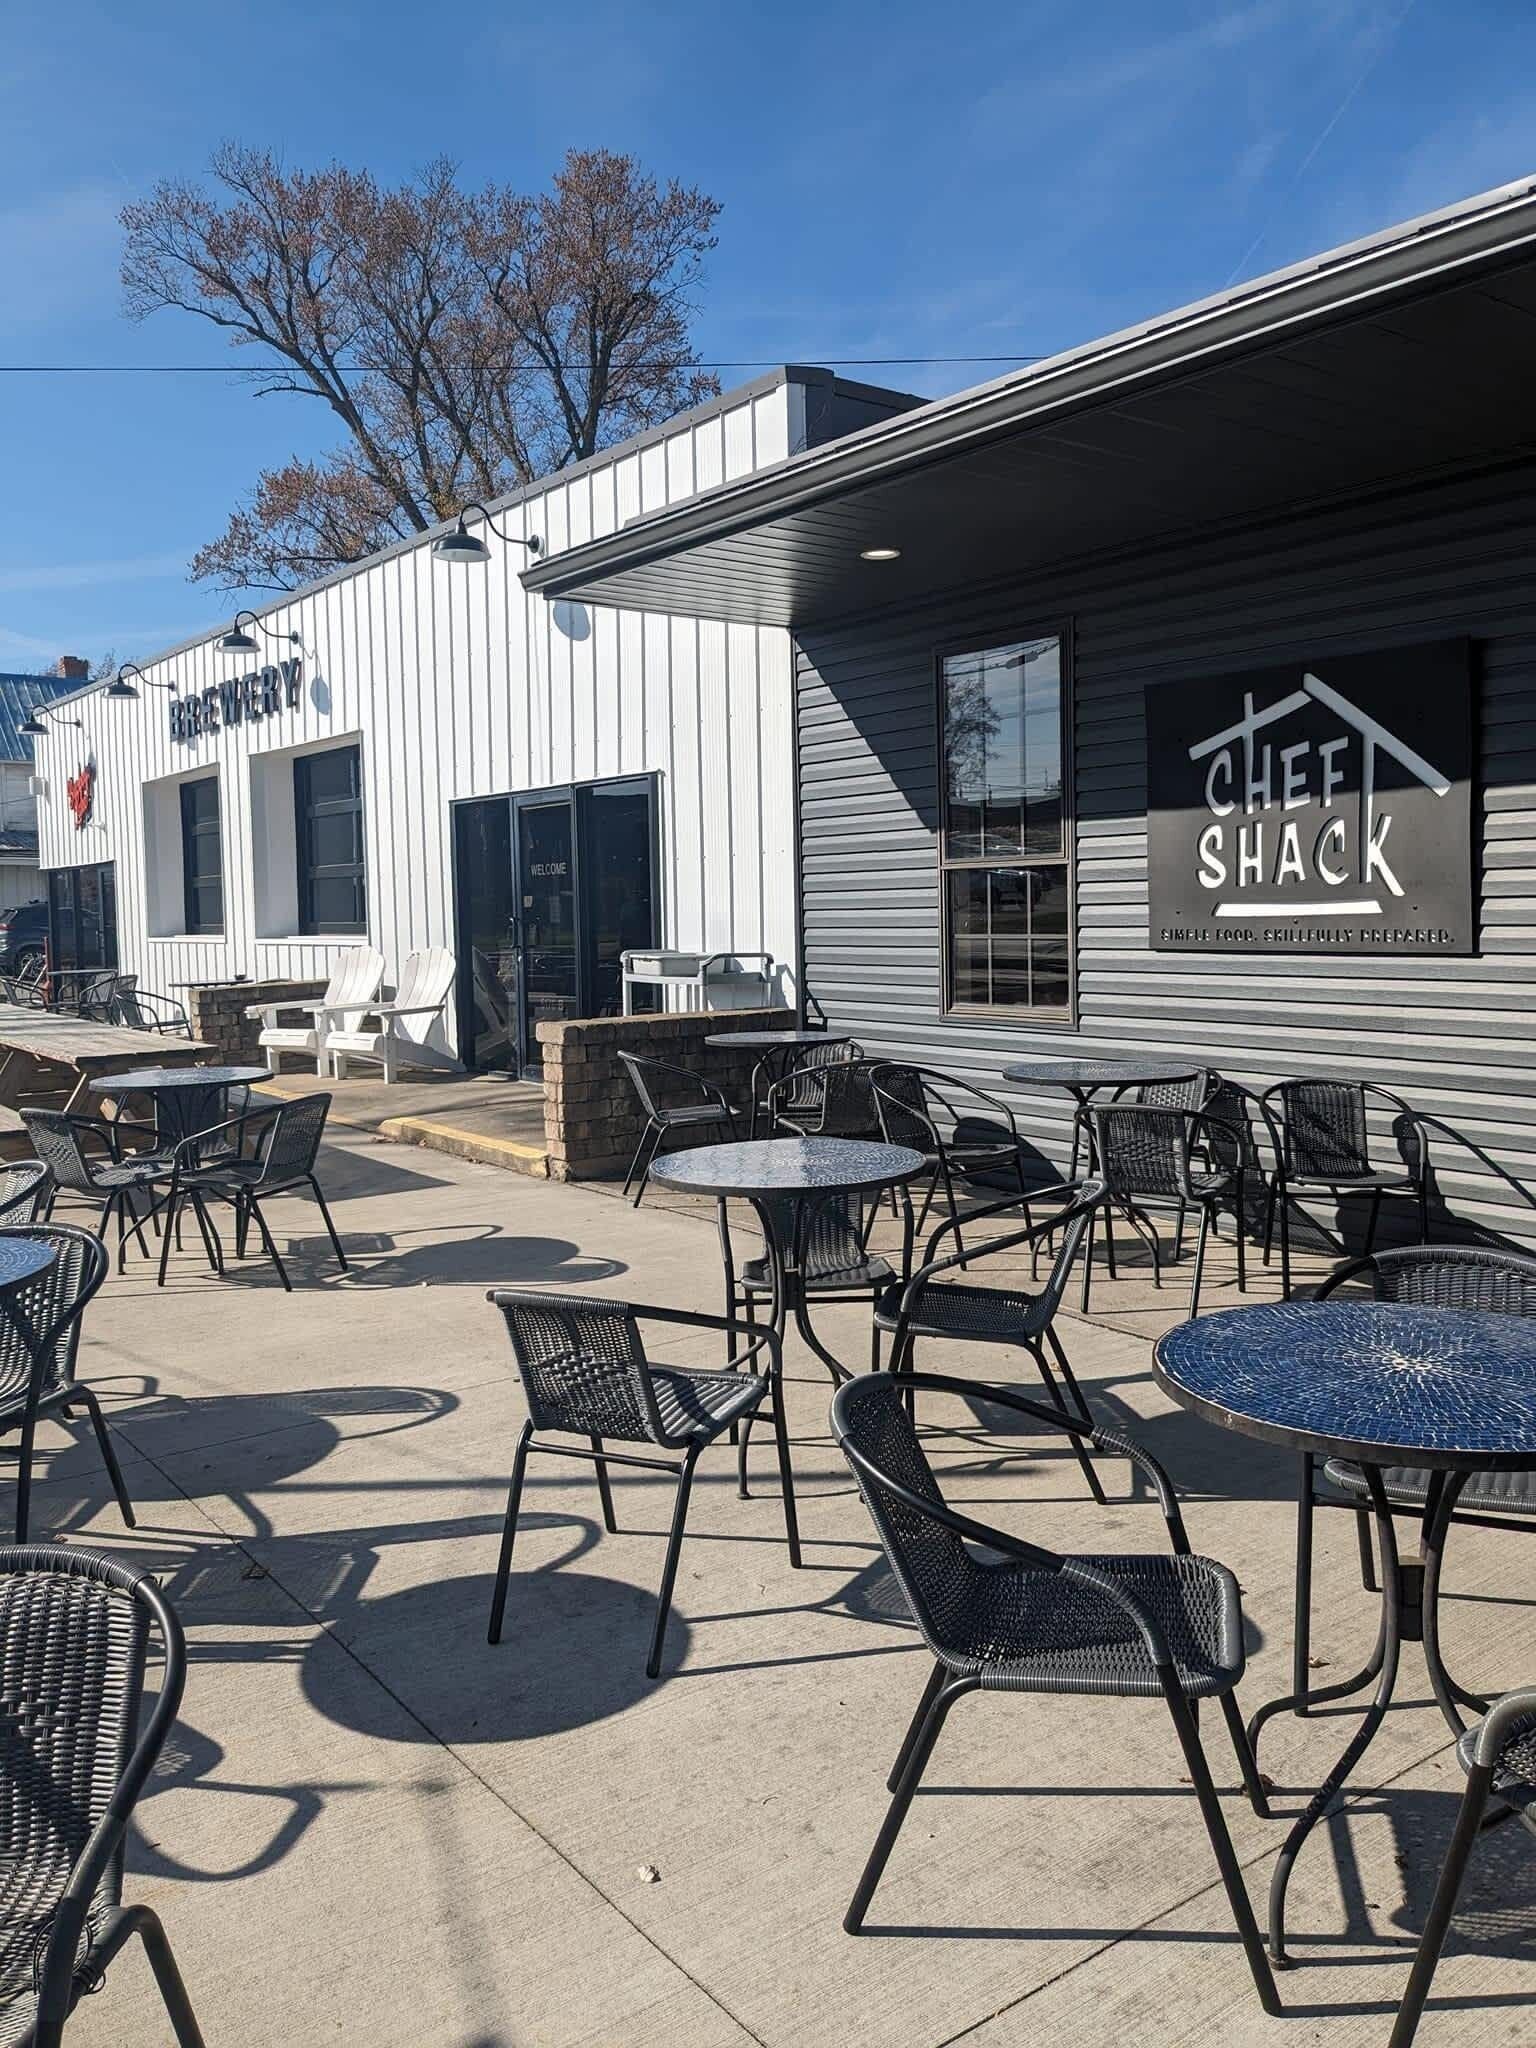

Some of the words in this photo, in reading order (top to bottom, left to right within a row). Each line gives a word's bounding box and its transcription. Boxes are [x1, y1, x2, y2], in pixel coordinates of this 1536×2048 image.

[169, 657, 302, 747] BREWERY
[1205, 732, 1348, 816] CHEF
[530, 862, 567, 877] WELCOME
[1196, 790, 1406, 896] SHACK
[1160, 928, 1209, 942] SIMPLE
[1215, 928, 1259, 943] FOOD.
[1263, 928, 1353, 943] SKILLFULLY
[1360, 928, 1455, 943] PREPARED.
